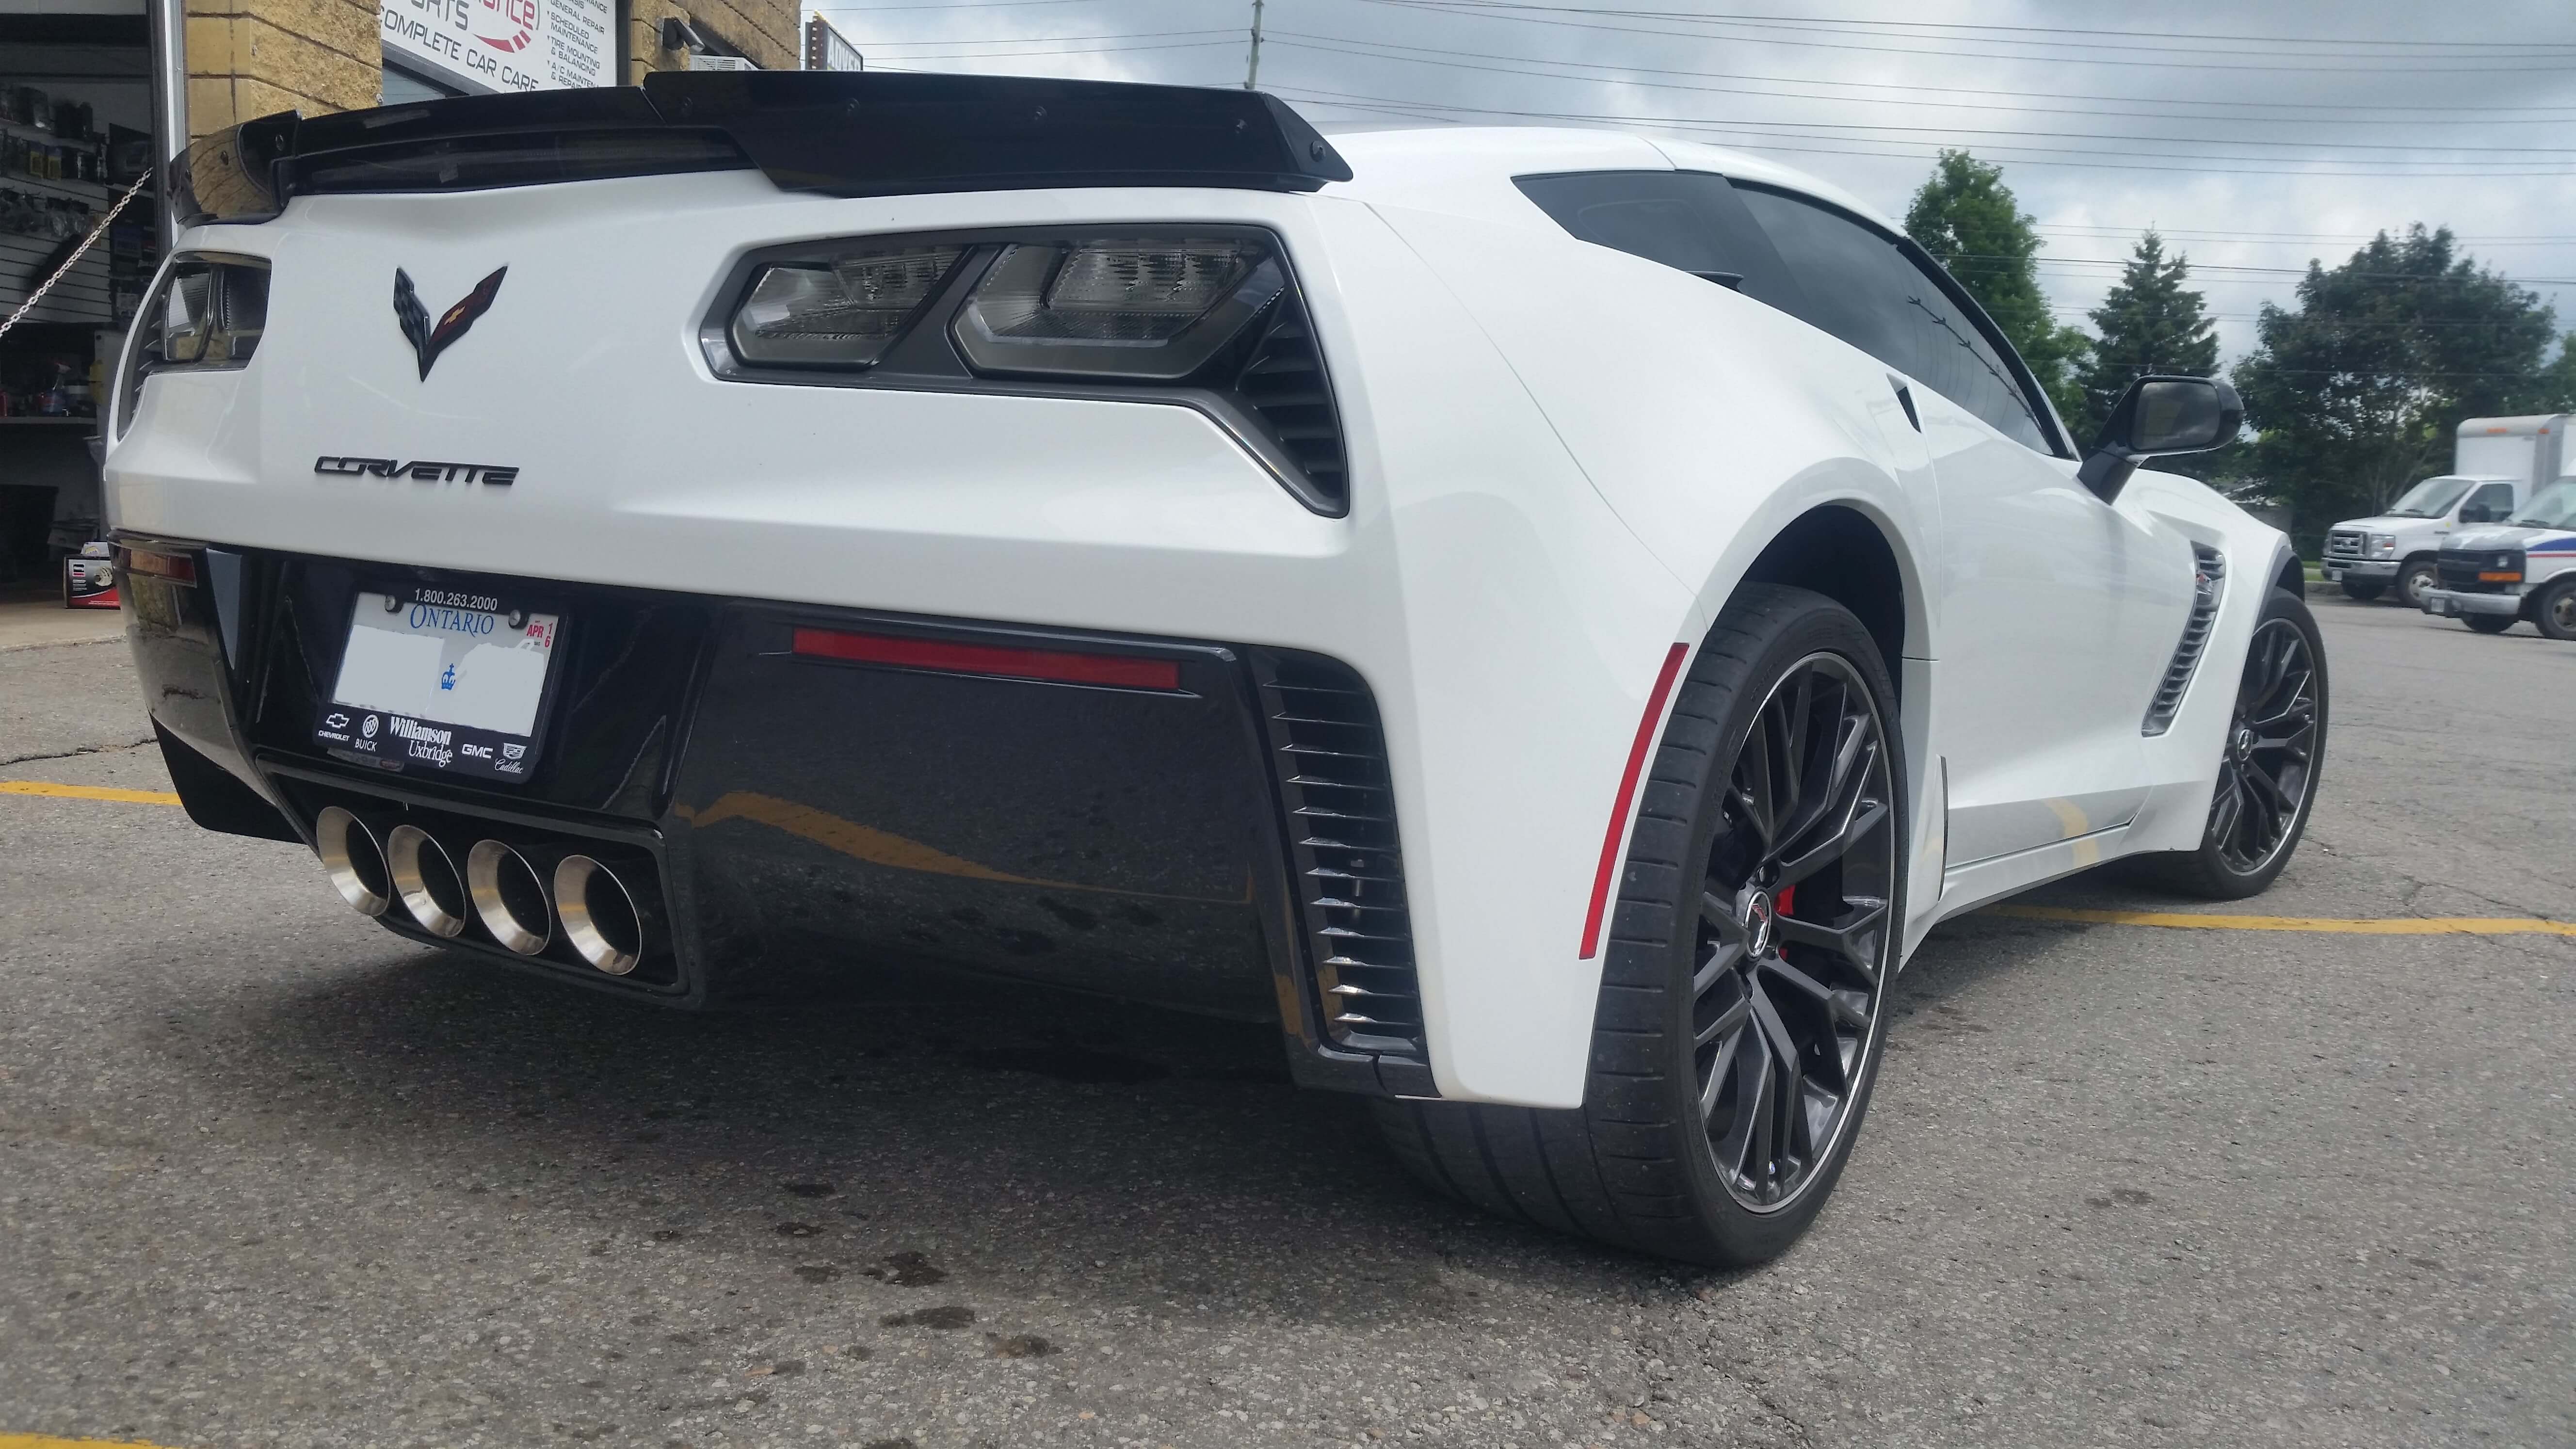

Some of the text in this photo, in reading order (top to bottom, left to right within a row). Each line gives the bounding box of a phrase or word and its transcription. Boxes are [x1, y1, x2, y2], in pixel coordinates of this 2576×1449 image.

[550, 0, 605, 34] GENERAL REPAIR
[587, 0, 607, 14] ANCE
[551, 12, 589, 39] SCHEDULED
[551, 22, 598, 54] MAINTENANCE
[381, 6, 461, 60] OMPLETE
[467, 48, 497, 77] CAR
[551, 36, 600, 69] TIRE MOUNTING
[551, 72, 556, 80] &
[552, 62, 599, 88] A/C MAINTEN
[559, 51, 596, 76] BALANCING
[315, 456, 519, 485] CORVETTE
[416, 588, 498, 611] 1.800.263.2000
[410, 604, 494, 637] ONTARIO
[527, 625, 544, 638] APR
[545, 636, 551, 647] 6
[318, 730, 350, 741] CHEVROLET
[390, 716, 452, 745] Williamson
[355, 738, 377, 752] BUICK
[409, 740, 453, 767] Uxbridge
[462, 744, 494, 759] GMC
[495, 758, 523, 774] Cadillac
